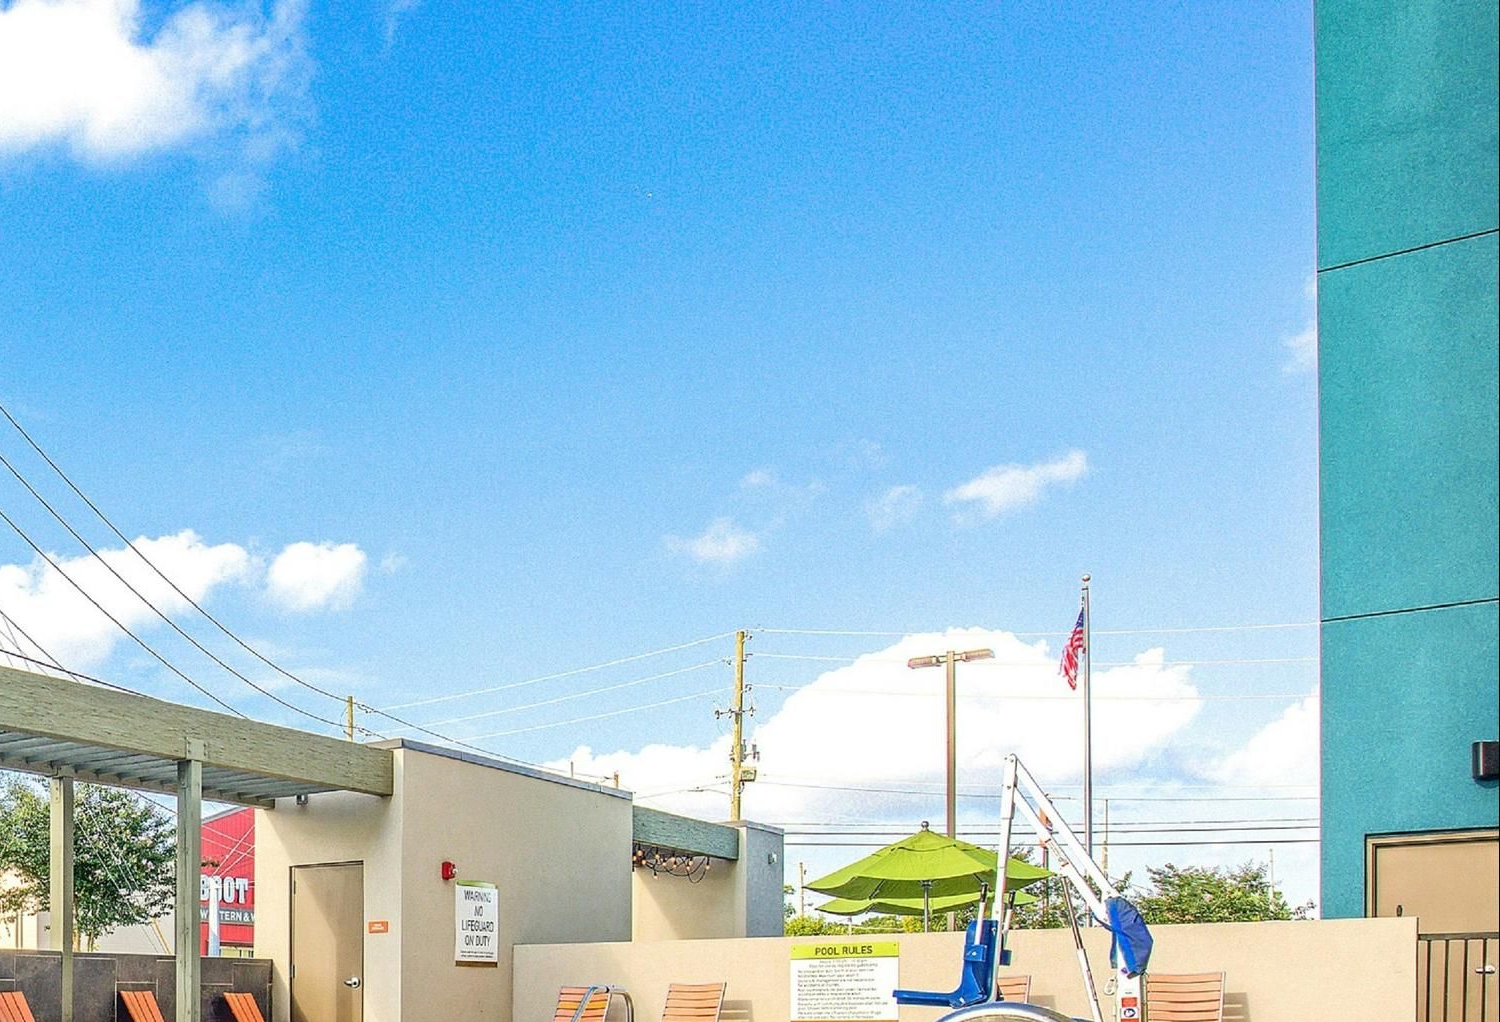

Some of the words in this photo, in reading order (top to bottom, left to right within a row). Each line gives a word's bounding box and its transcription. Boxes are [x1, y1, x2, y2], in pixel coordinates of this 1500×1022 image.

[464, 889, 492, 903] WARNING
[200, 908, 243, 921] WTERN
[474, 905, 484, 917] NO
[461, 920, 494, 933] LIFEGUARD
[464, 935, 474, 946] ON
[475, 935, 491, 946] DUTY
[815, 947, 839, 956] POOL
[842, 945, 873, 955] RULES
